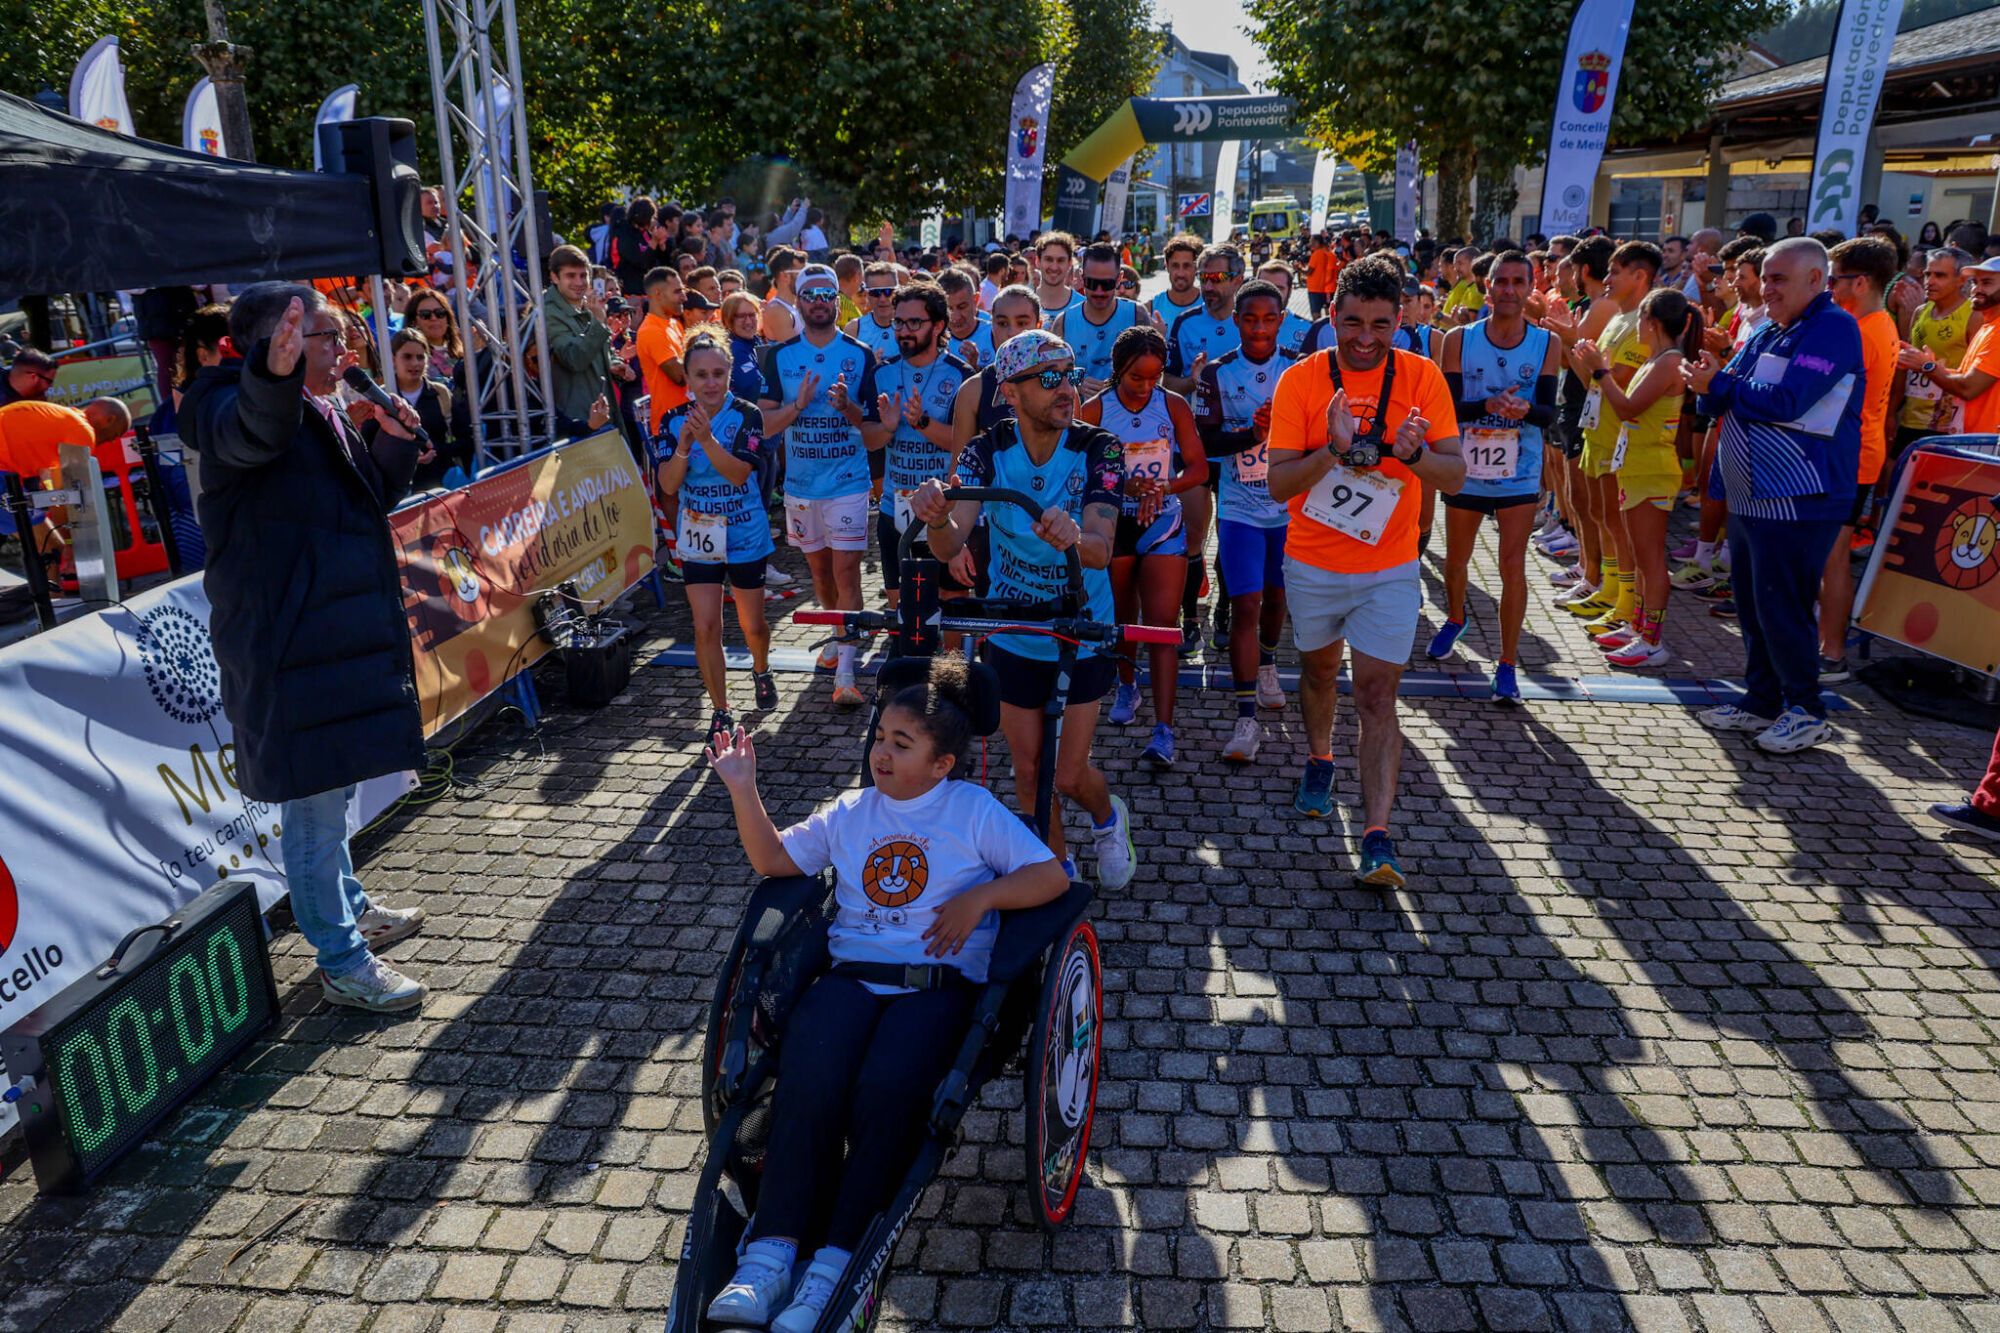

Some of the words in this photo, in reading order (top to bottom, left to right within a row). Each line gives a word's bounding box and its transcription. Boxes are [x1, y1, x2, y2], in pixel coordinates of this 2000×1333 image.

[1218, 102, 1287, 118] Deputación
[1560, 138, 1574, 149] de
[791, 416, 852, 429] IVERSIDA
[1951, 405, 1960, 422] 7
[792, 429, 850, 444] INCLUSIÓN
[791, 445, 856, 459] VISIBILIDAD
[1470, 446, 1507, 466] 112
[480, 498, 560, 557] CARREIRA
[557, 490, 571, 518] E
[571, 465, 633, 511] ANDAINA
[1331, 484, 1374, 518] 97
[582, 501, 600, 542] de
[686, 528, 714, 553] 116
[157, 743, 236, 826] Me
[184, 837, 215, 868] teu
[215, 801, 270, 847] camiño
[0, 944, 63, 1006] cello
[59, 925, 249, 1152] 00:00
